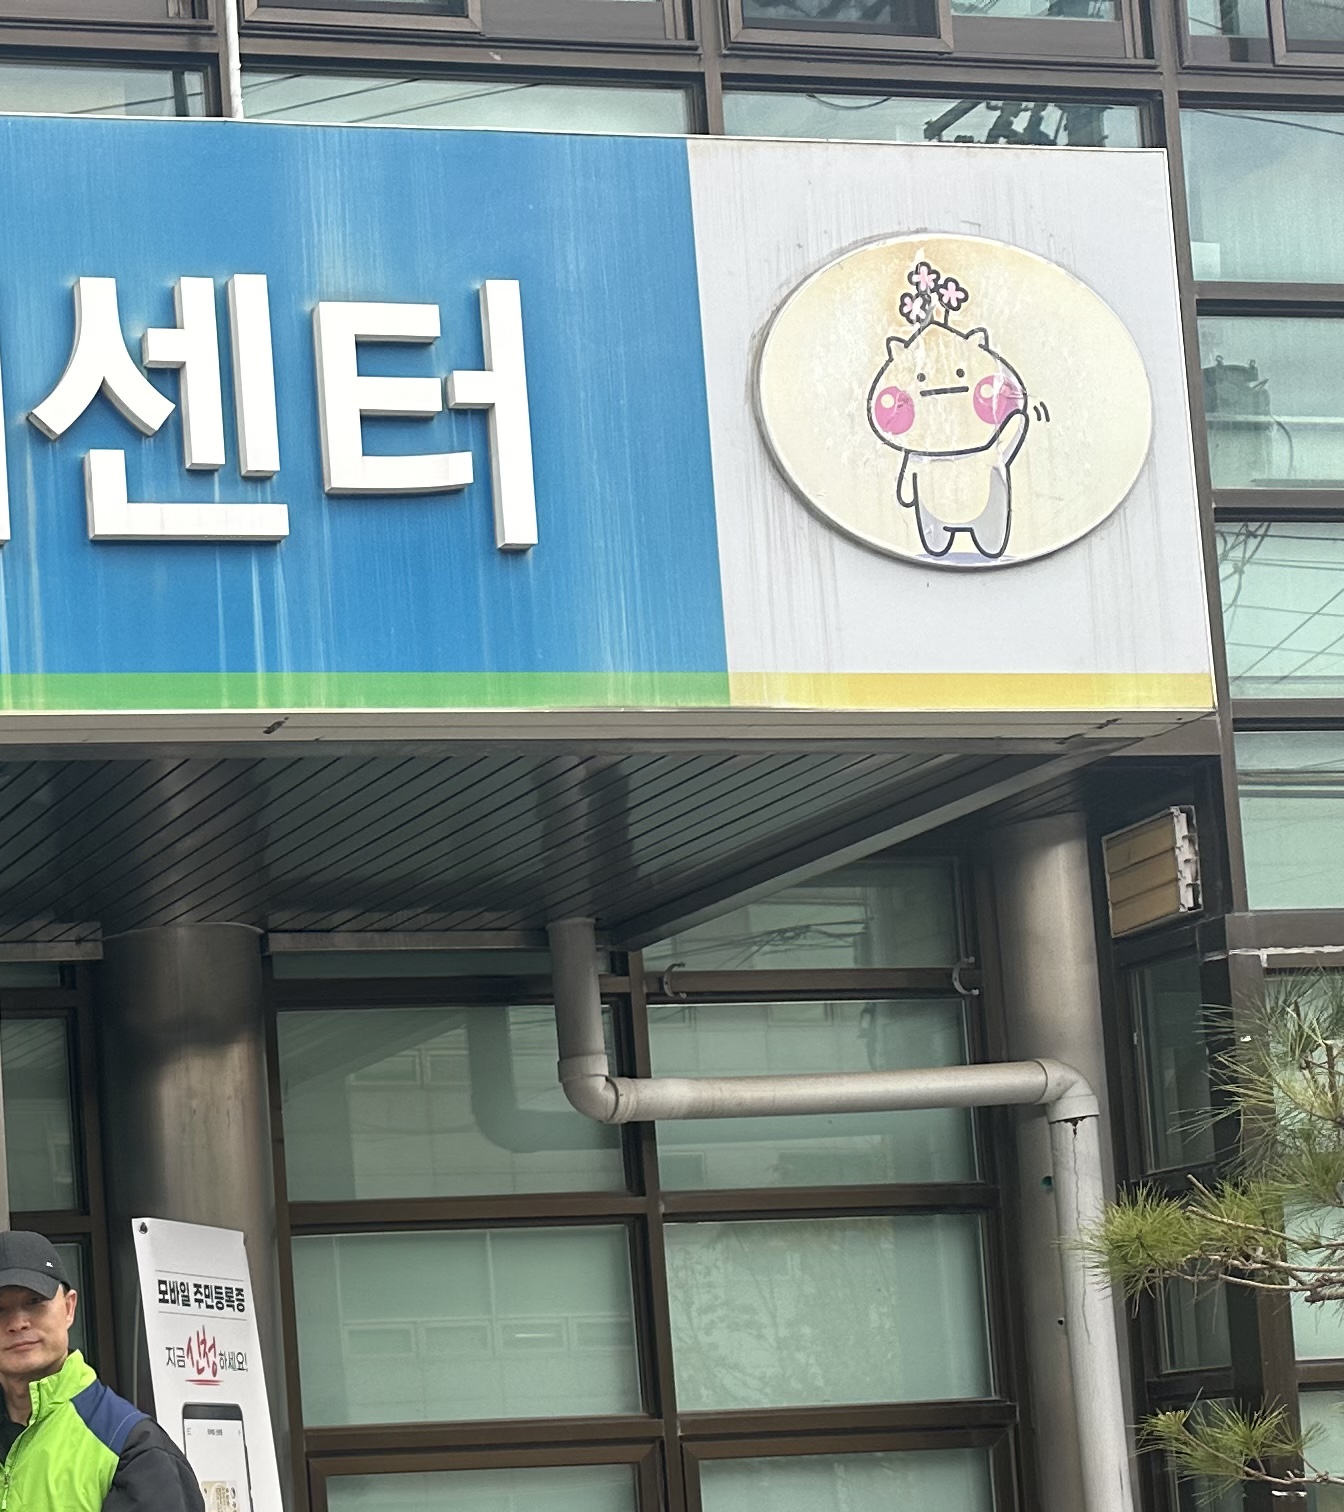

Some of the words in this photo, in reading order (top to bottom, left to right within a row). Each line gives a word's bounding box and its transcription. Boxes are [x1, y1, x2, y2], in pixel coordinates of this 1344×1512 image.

[158, 1279, 192, 1308] 모바일
[193, 1282, 246, 1314] 주민등록증
[166, 1346, 186, 1370] 지금
